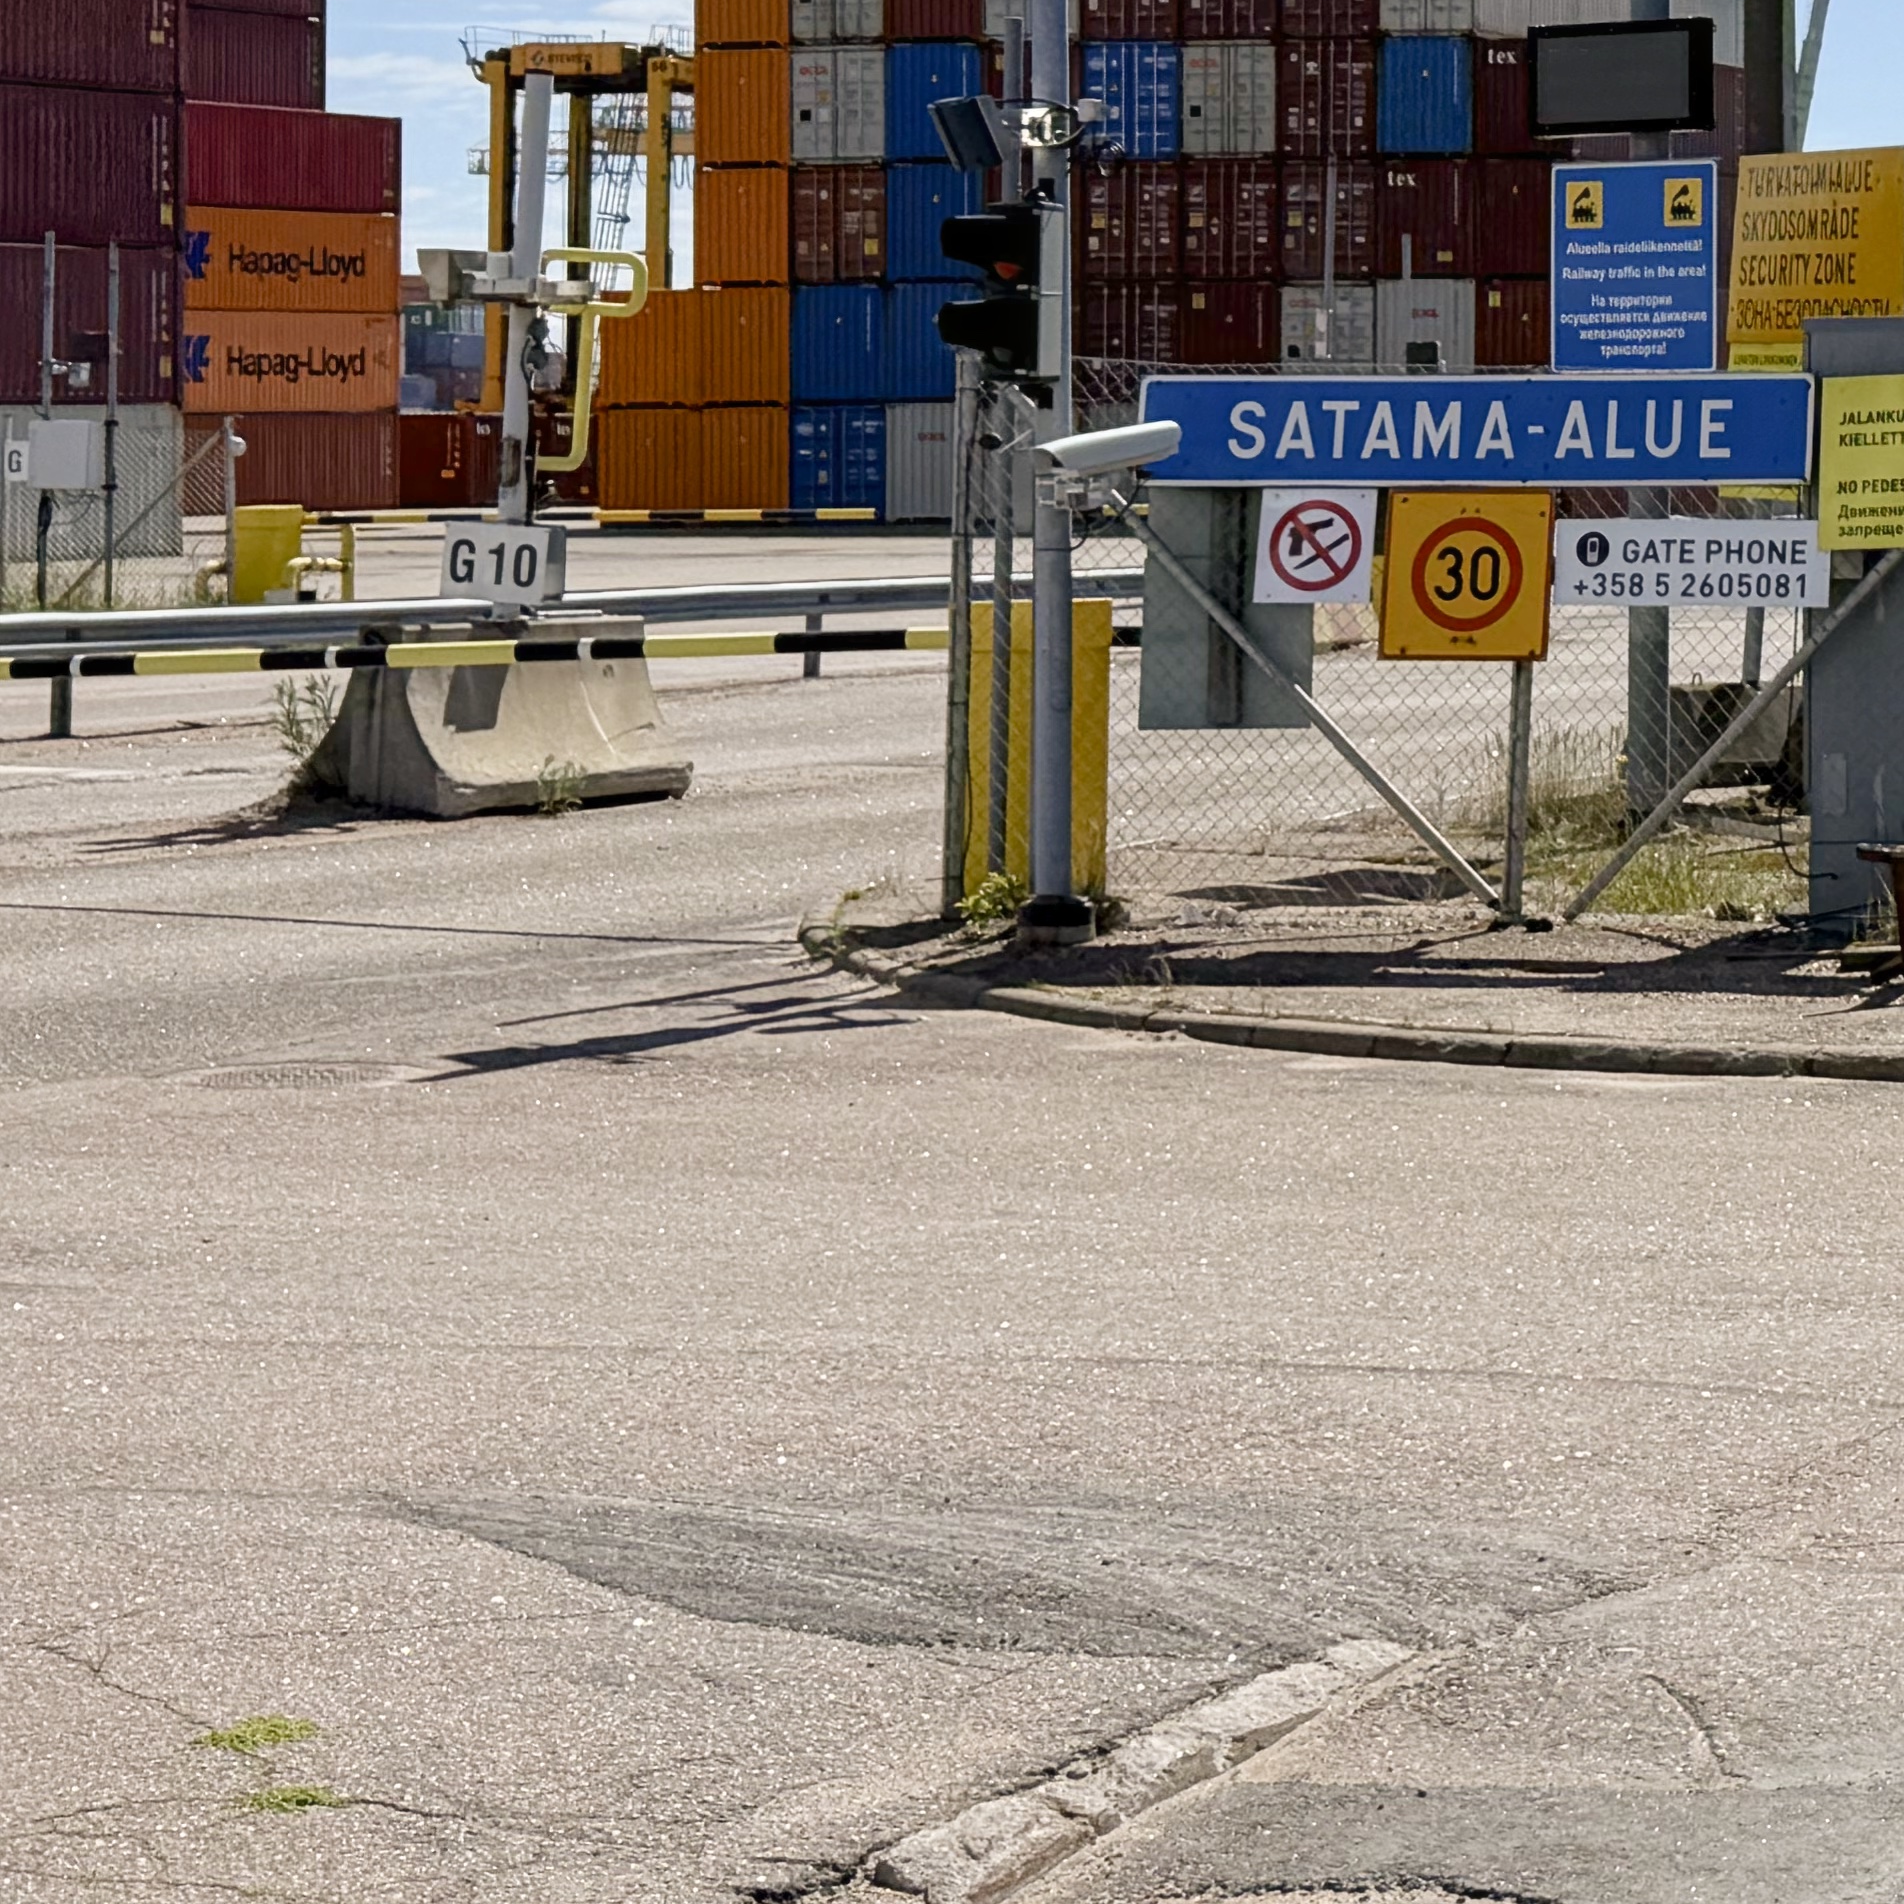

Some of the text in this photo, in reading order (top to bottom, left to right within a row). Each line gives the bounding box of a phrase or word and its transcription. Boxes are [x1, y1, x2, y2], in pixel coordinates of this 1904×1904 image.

[1487, 49, 1517, 64] tex
[1387, 171, 1416, 187] tex
[1748, 160, 1874, 198] TURVATOIMIALUE
[1742, 199, 1860, 241] SKYDDSOMRÅDE
[227, 243, 366, 283] Hapag-Lloyd
[1562, 266, 1606, 282] Railway
[1608, 265, 1641, 278] traffic
[1644, 265, 1655, 278] in
[1657, 265, 1675, 278] the
[1739, 252, 1857, 286] SECURITY ZONE
[1591, 294, 1606, 307] На
[1736, 298, 1772, 330] ЗОНА
[226, 345, 366, 383] Hapag-Lloyd
[1227, 399, 1734, 460] SATAMA-ALUE
[1837, 479, 1858, 495] NO
[1622, 539, 1808, 565] GATE PHONE
[1434, 546, 1500, 601] 30
[1573, 572, 1807, 598] +358 5 2605081
